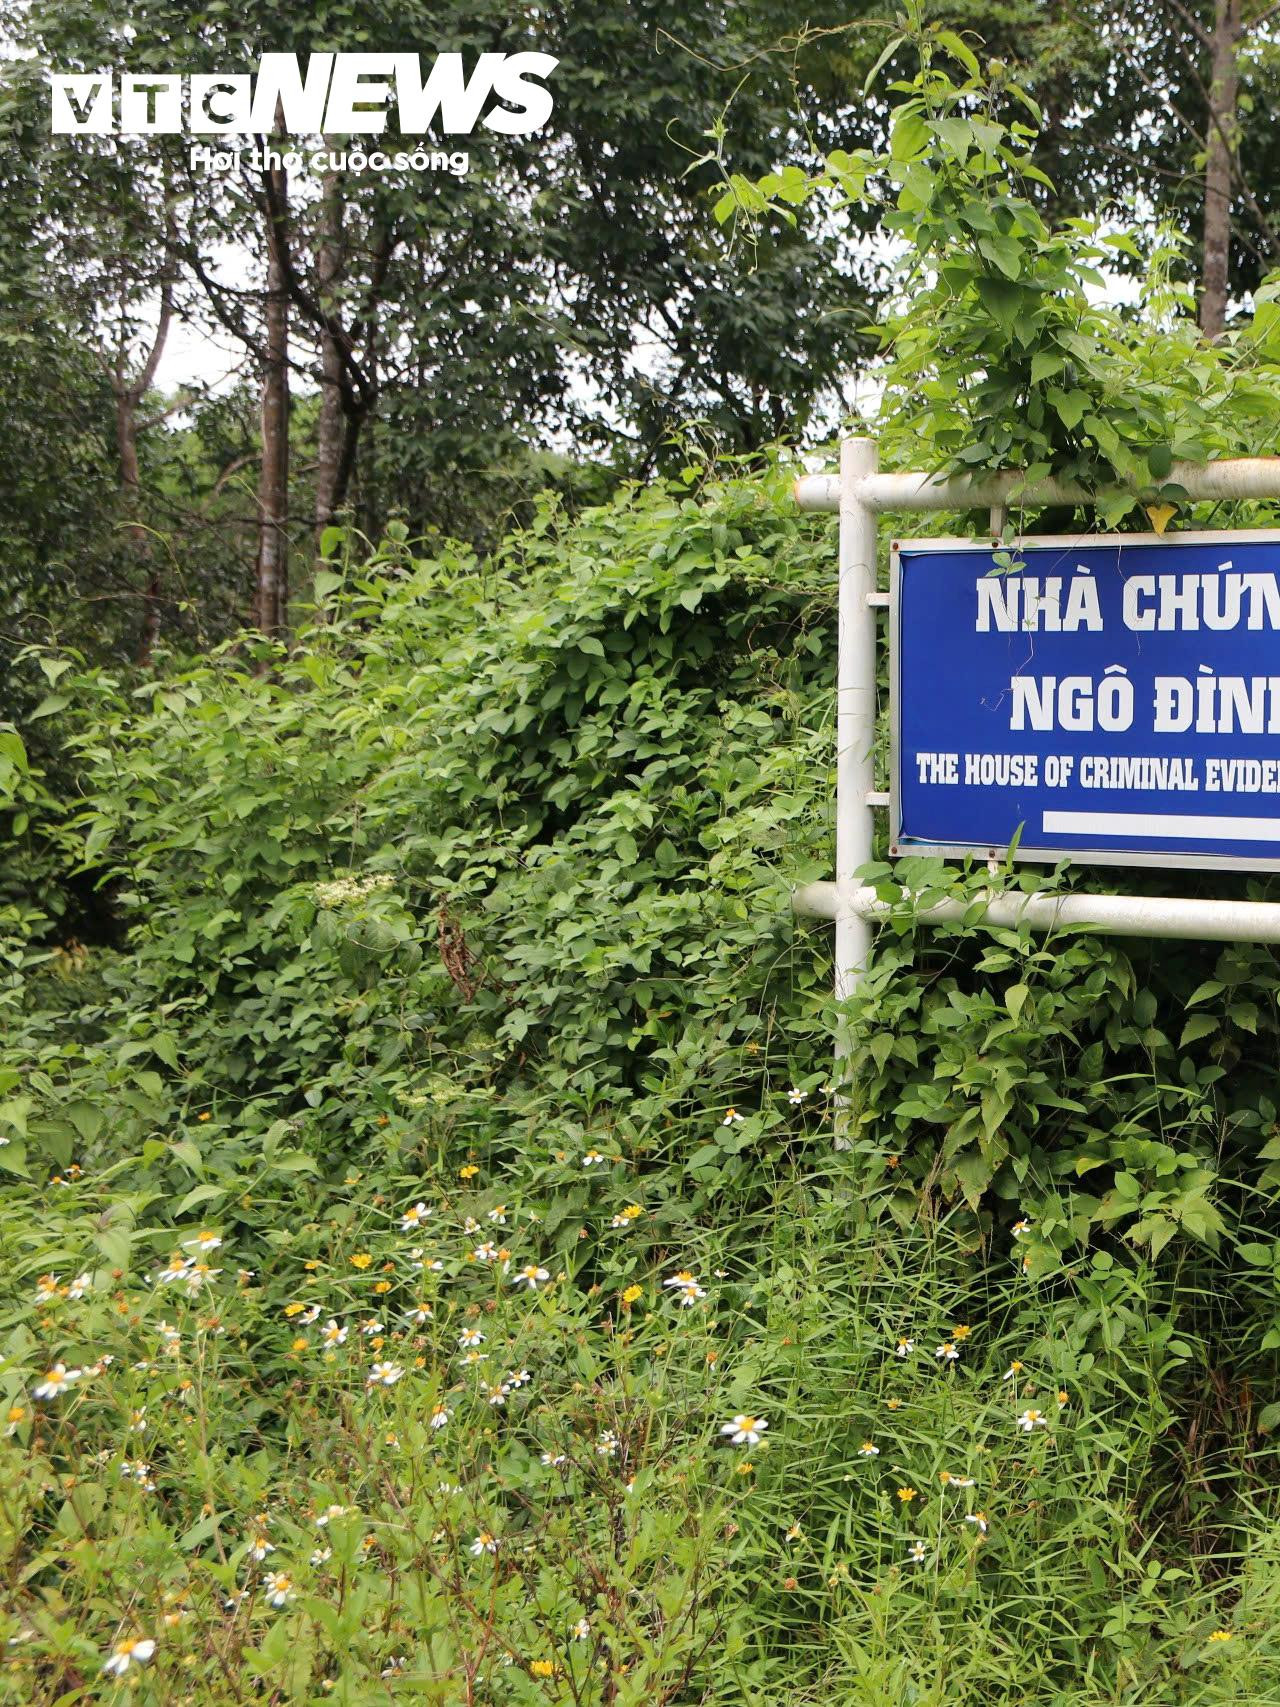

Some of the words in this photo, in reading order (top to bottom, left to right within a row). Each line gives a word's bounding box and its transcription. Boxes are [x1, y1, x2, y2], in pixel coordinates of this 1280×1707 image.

[976, 564, 1103, 631] NHÀ
[1010, 664, 1133, 731] NGÔ
[917, 753, 958, 784] THE
[965, 754, 1038, 786] HOUSE
[1045, 756, 1073, 787] OF
[1080, 757, 1198, 790] CRIMINAL
